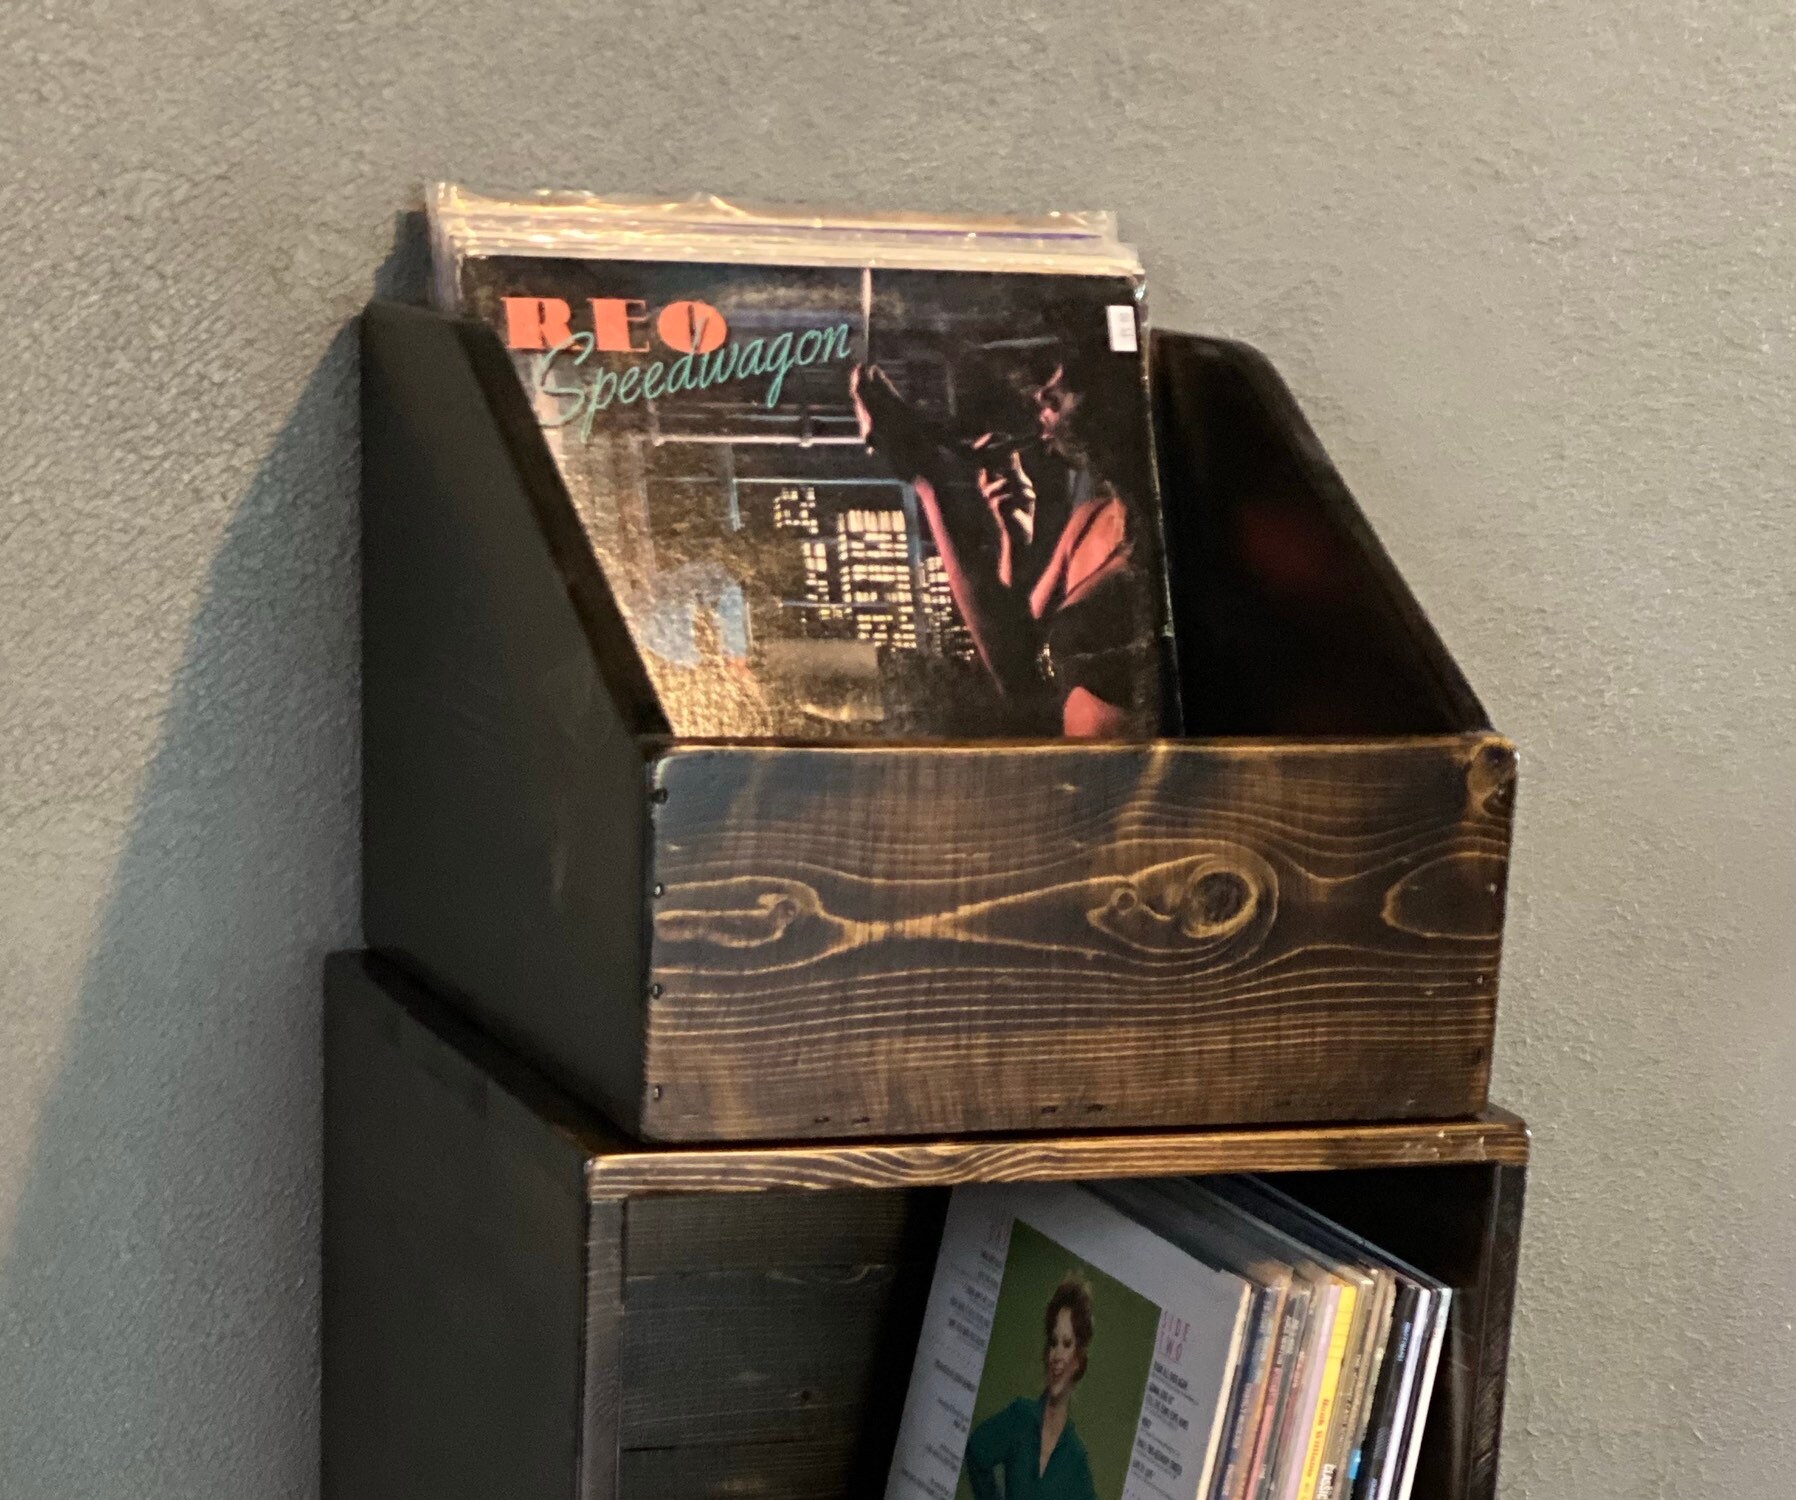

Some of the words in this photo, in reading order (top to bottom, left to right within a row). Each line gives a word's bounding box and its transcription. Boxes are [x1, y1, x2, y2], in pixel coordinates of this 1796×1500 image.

[500, 297, 728, 354] REO
[533, 323, 850, 443] Speedwagon
[1317, 1398, 1329, 1427] Hank
[1307, 1430, 1324, 1477] Williams
[1317, 1463, 1337, 1500] CLASSIC
